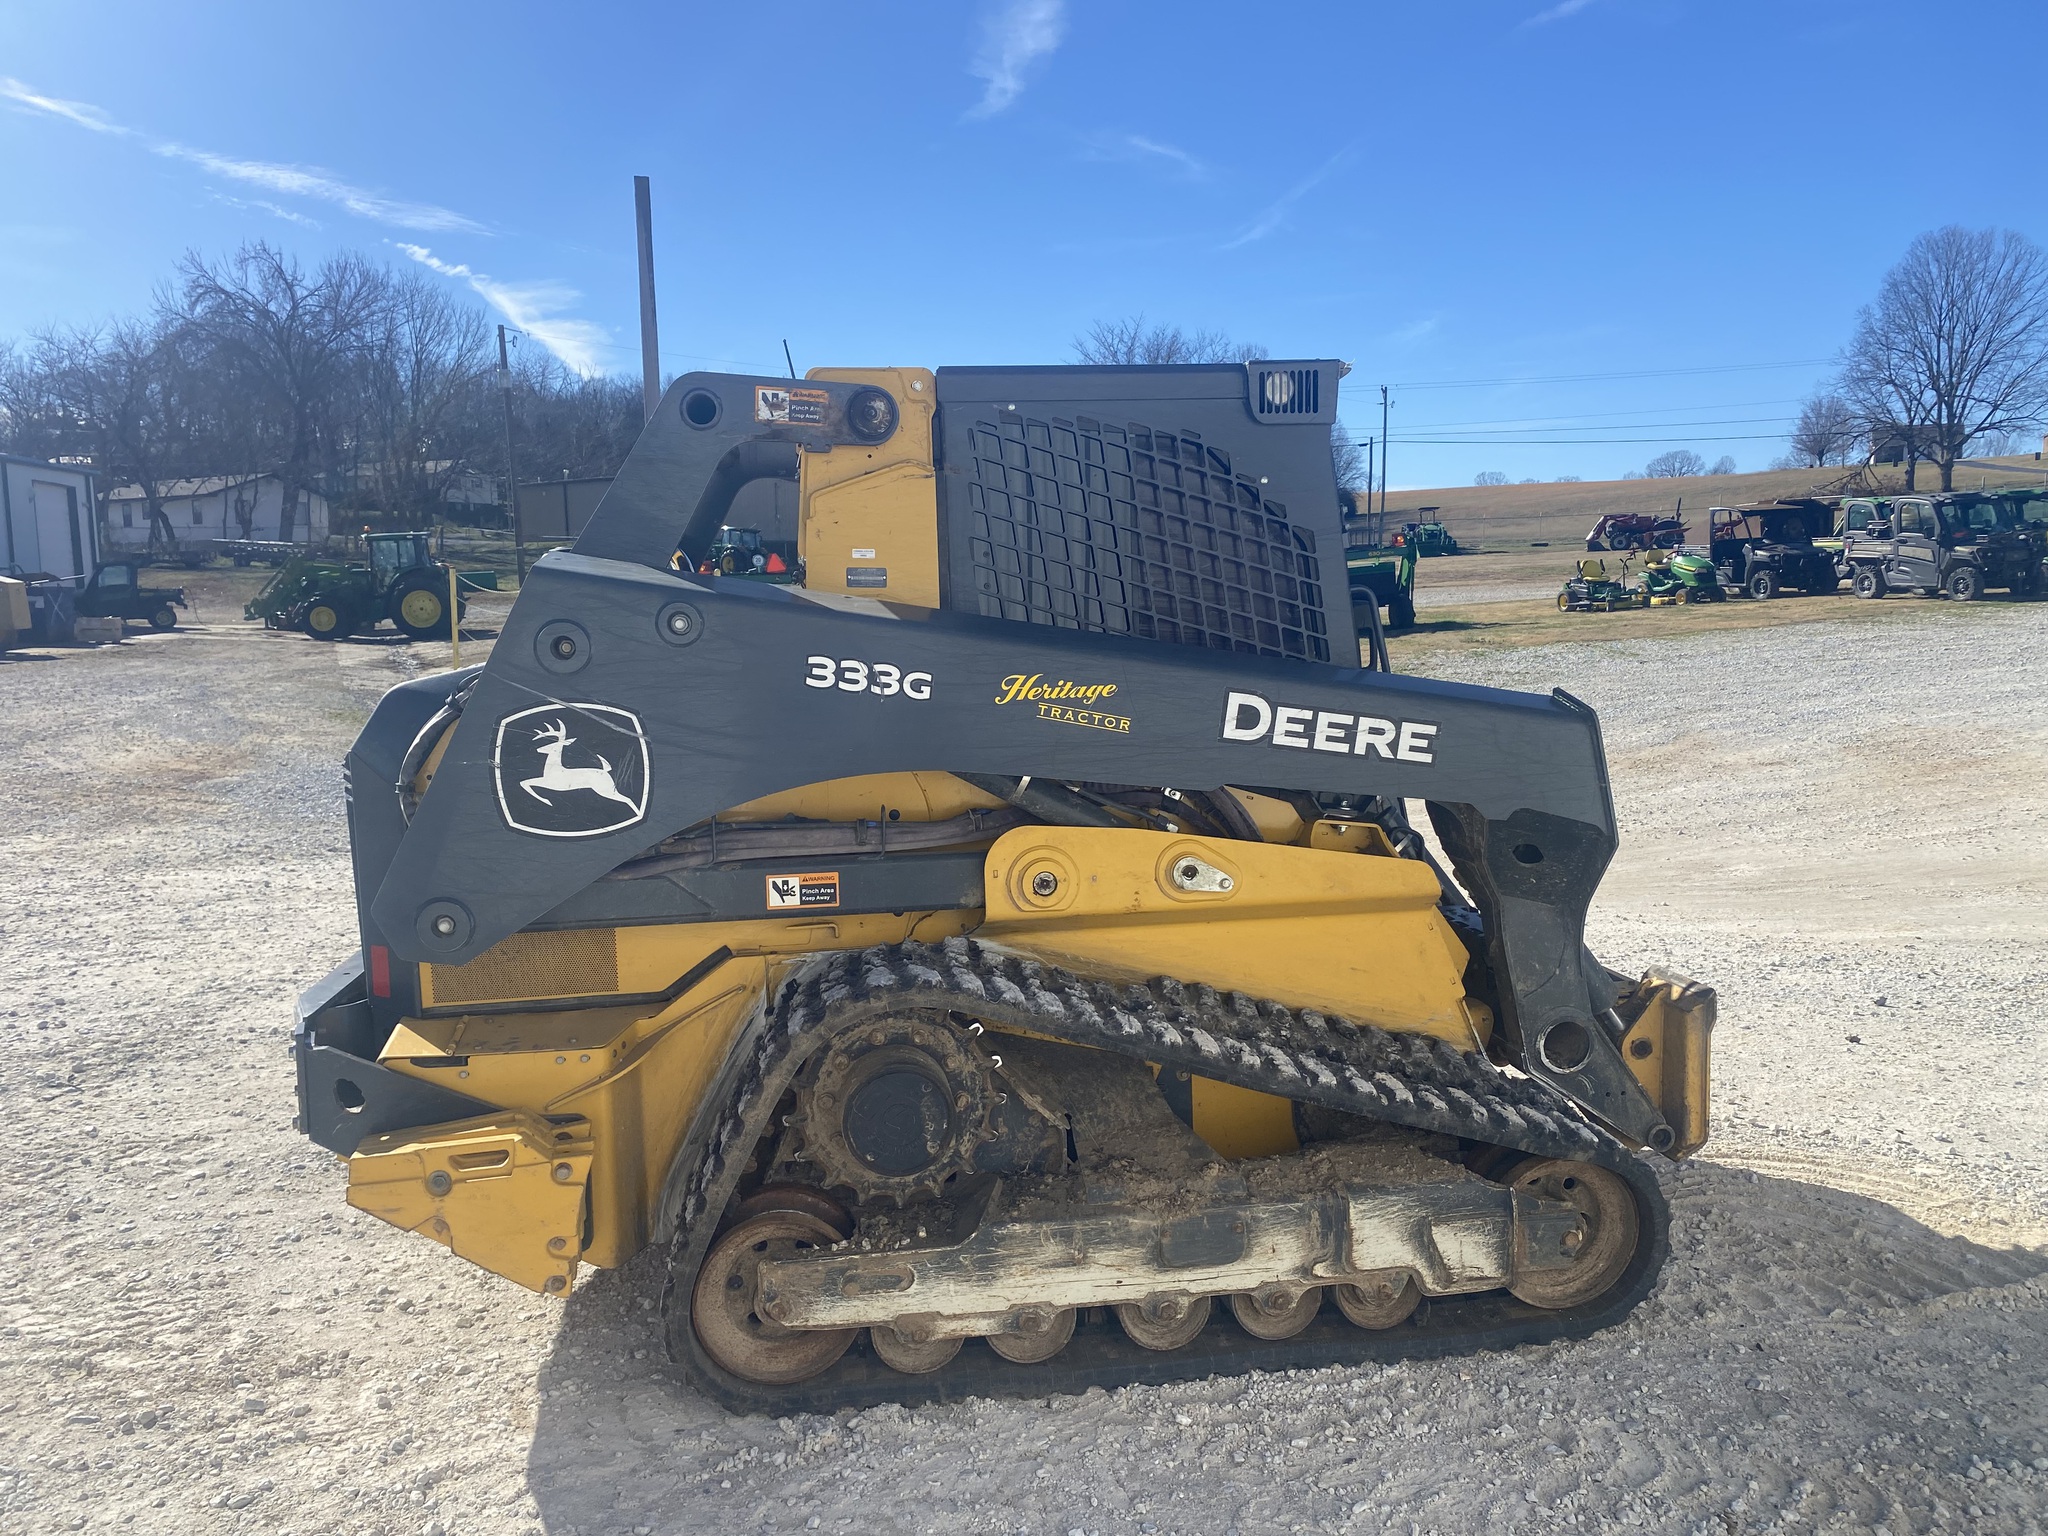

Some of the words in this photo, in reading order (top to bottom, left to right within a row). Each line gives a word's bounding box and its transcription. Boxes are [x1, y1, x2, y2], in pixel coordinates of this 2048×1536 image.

[805, 655, 932, 700] 333G
[994, 673, 1119, 705] Heritage
[1038, 704, 1131, 731] TRACTOR
[1222, 691, 1438, 764] DEERE
